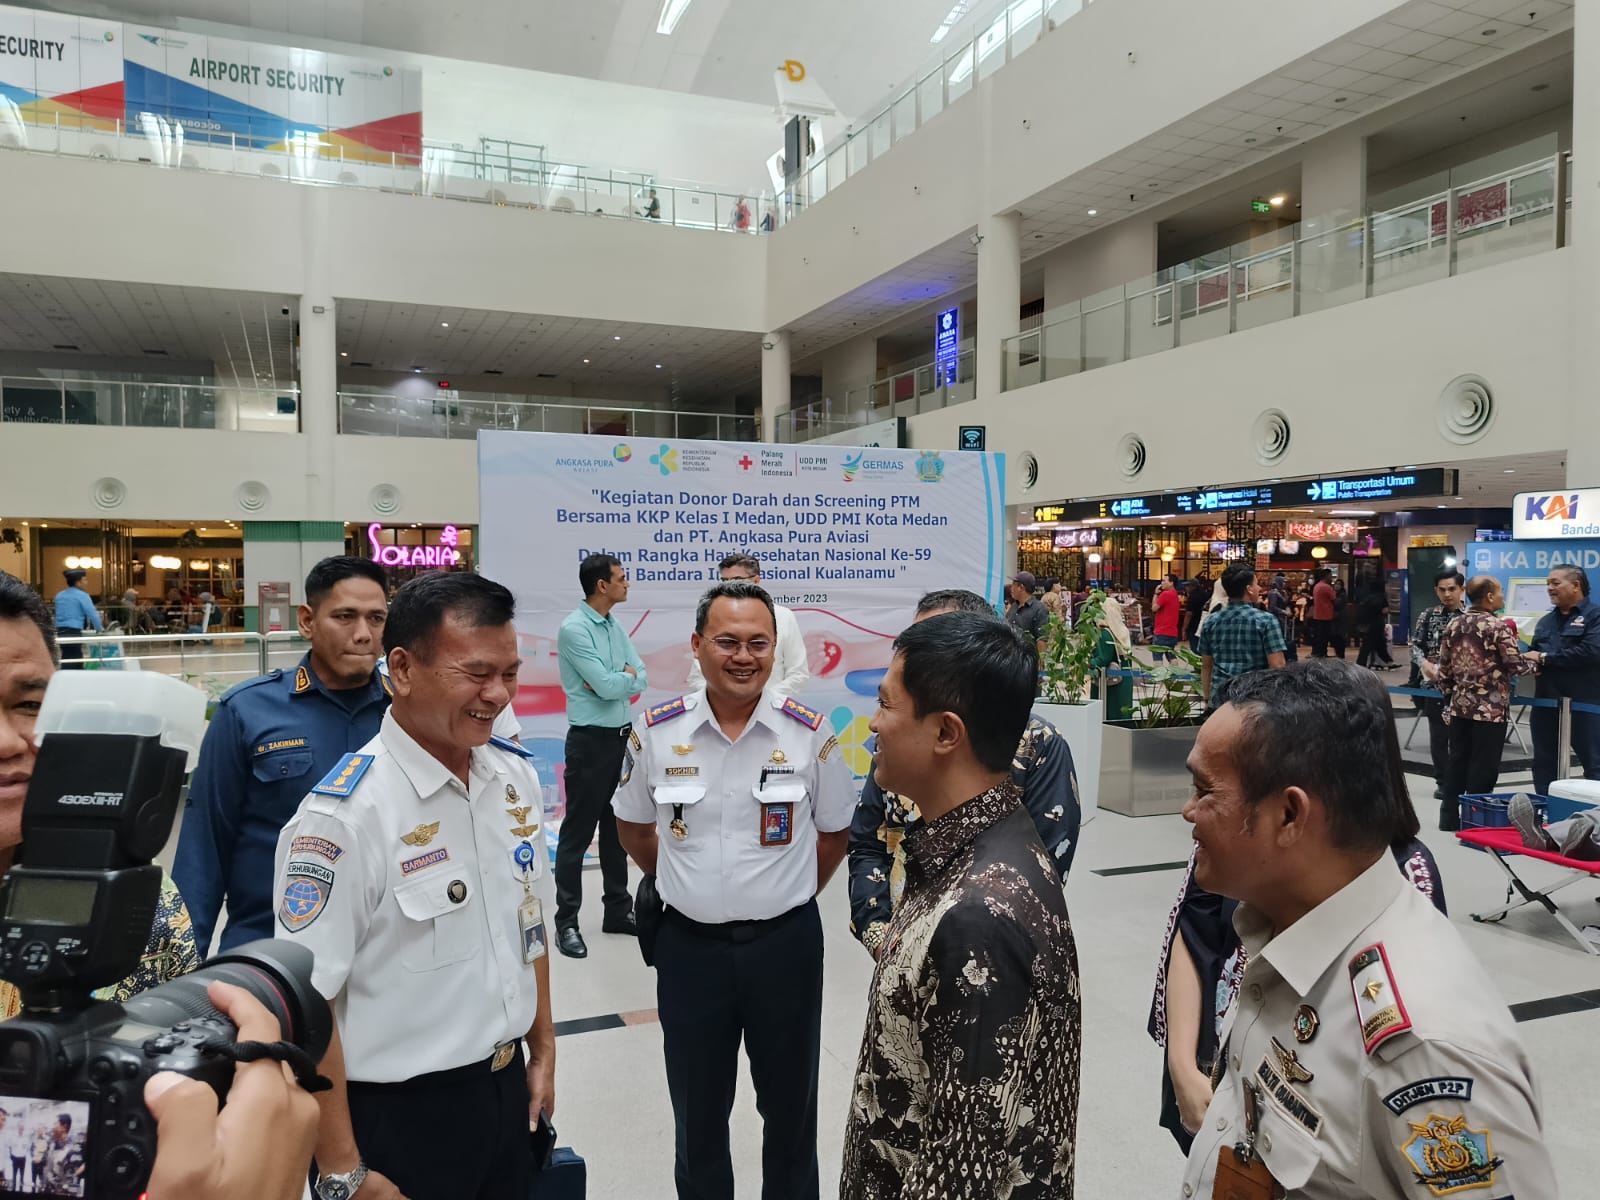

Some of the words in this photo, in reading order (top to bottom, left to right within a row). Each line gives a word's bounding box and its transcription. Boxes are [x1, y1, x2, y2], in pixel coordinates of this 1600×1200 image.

[189, 57, 261, 86] AIRPORT
[266, 68, 345, 96] SECURITY
[761, 450, 784, 459] Palang
[799, 457, 814, 465] UDD
[815, 457, 828, 465] PMI
[555, 458, 592, 467] ANGKASA
[593, 459, 613, 468] PURA
[862, 460, 904, 470] GERMAS
[761, 469, 793, 477] Indonesia
[1338, 477, 1385, 491] Transportasi
[1386, 476, 1415, 487] Umum
[592, 489, 674, 507] "Kegiatan
[679, 491, 728, 506] Donor
[732, 492, 778, 507] Darah
[782, 493, 810, 507] dan
[815, 494, 886, 510] Screening
[891, 495, 920, 508] PTM
[556, 509, 631, 523] Bersama
[637, 510, 670, 524] KKP
[675, 510, 718, 524] Kelas
[722, 511, 730, 524] I
[735, 511, 789, 527] Medan,
[795, 512, 827, 525] UDD
[832, 513, 860, 525] PMI
[866, 513, 898, 526] Kota
[902, 513, 948, 526] Medan
[1561, 523, 1600, 535] Banda
[654, 529, 683, 543] dan
[689, 530, 713, 543] PT.
[718, 530, 783, 546] Angkasa
[789, 530, 822, 543] Pura
[826, 530, 869, 543] Aviasi
[578, 548, 632, 562] Dam
[638, 549, 698, 565] Rangka
[825, 548, 886, 561] Nasional
[891, 548, 932, 561] Ke-59
[1500, 551, 1530, 569] KA
[636, 568, 703, 581] Bandara
[708, 567, 810, 581] Iasional
[815, 566, 896, 580] Kualanamu
[773, 594, 800, 604] mber
[803, 594, 828, 603] 2023
[268, 738, 305, 750] ZAKIRMAN
[295, 837, 338, 851] EMENTERIAN
[403, 850, 446, 872] SARMANTO
[288, 864, 331, 880] ERHUBUNGAN
[1392, 1083, 1435, 1108] DITJEN
[1438, 1081, 1464, 1094] P2P
